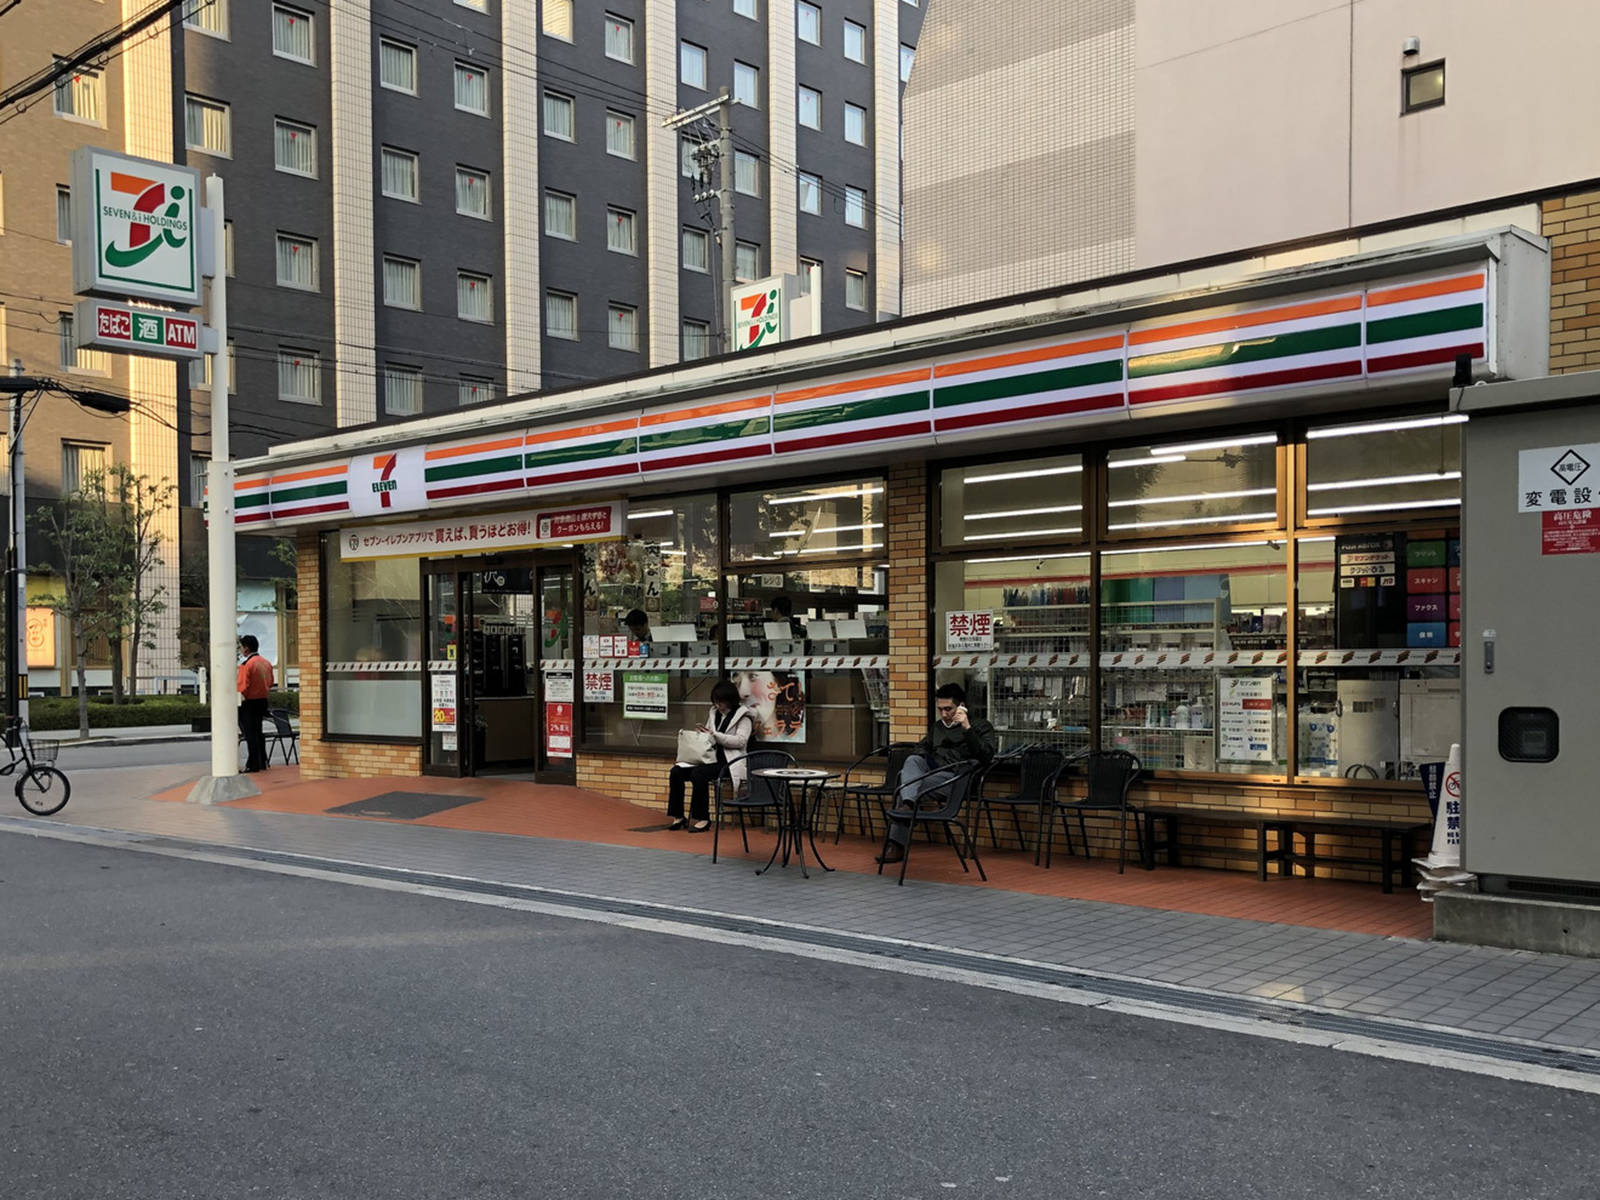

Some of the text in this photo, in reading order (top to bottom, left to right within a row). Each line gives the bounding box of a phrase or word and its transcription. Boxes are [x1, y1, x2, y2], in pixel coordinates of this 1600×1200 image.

[143, 214, 188, 231] HOLDINGS
[99, 312, 130, 336] たばこ
[138, 317, 158, 340] 酒
[167, 323, 195, 345] ATM
[1558, 462, 1582, 472] 高電圧
[1525, 487, 1600, 508] 変電設
[950, 613, 991, 637] 禁煙
[585, 673, 612, 691] 禁煙
